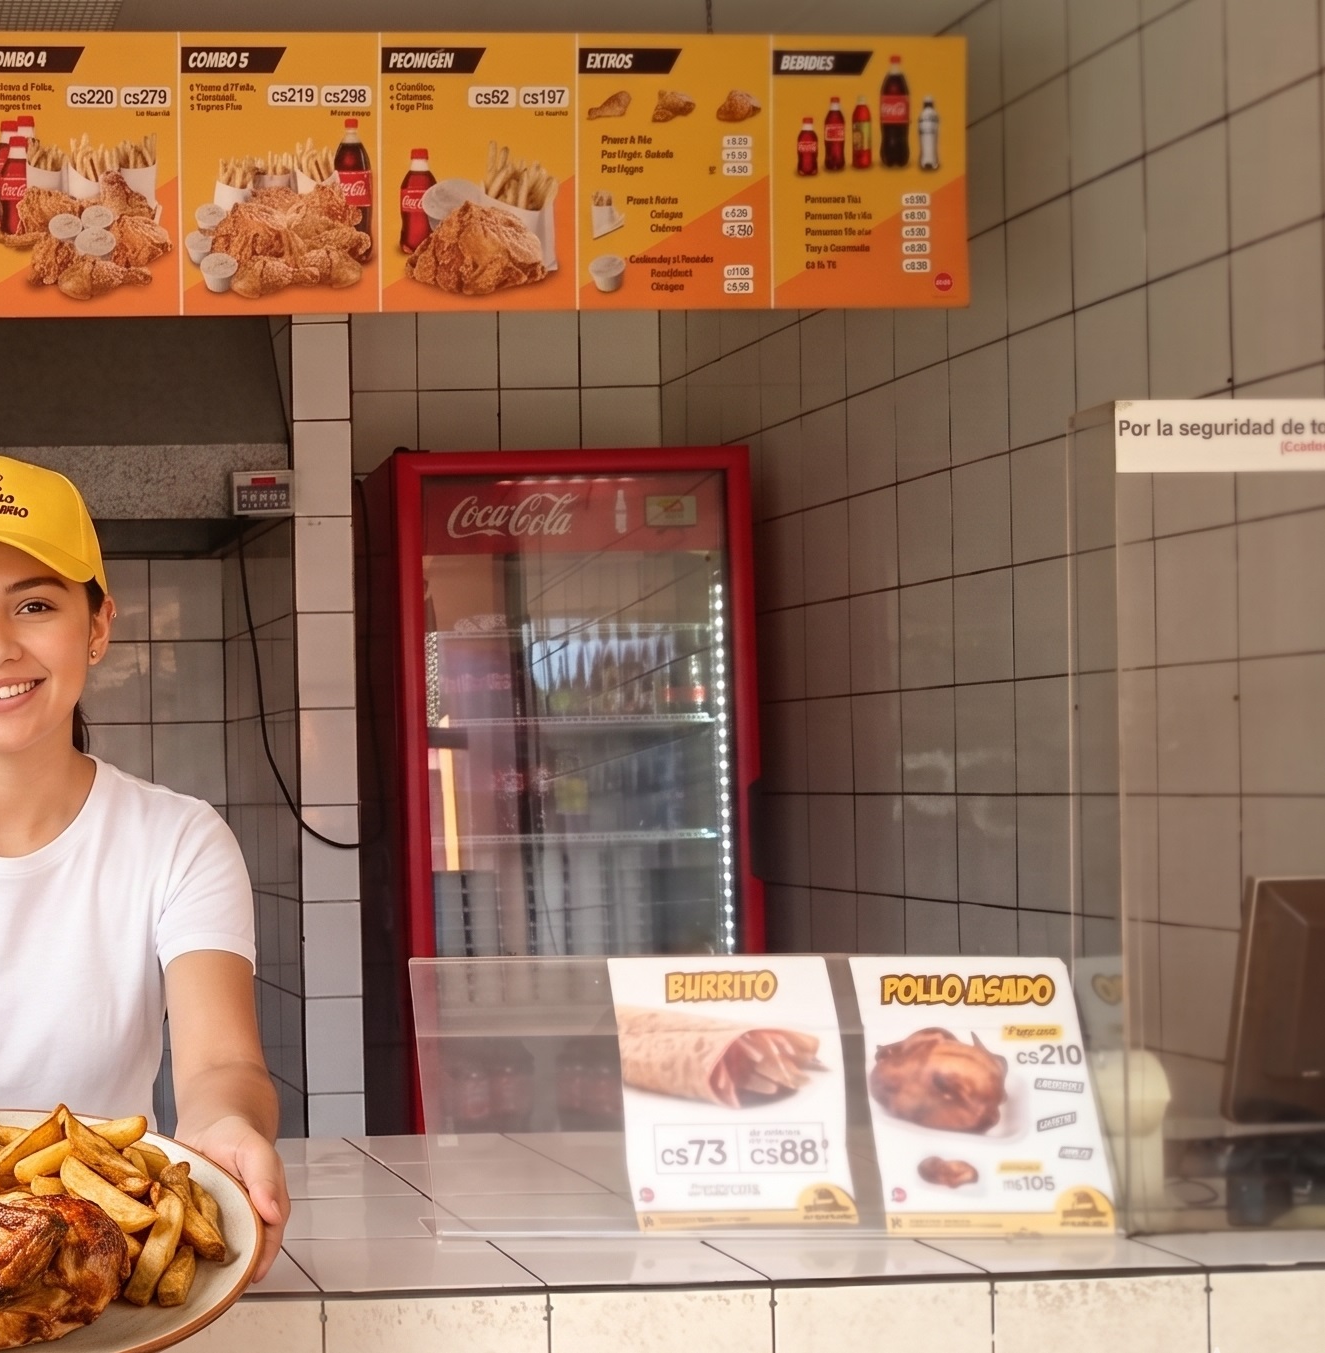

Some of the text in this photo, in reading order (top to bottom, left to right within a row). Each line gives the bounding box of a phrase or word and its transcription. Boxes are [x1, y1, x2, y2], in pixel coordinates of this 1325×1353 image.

[37, 52, 47, 68] 4
[188, 52, 249, 68] COMBO 5
[586, 53, 634, 69] EXTROS
[780, 55, 835, 71] BEBIDIES
[70, 90, 113, 104] cs220
[124, 90, 167, 104] cs279
[272, 88, 314, 103] cs219
[325, 89, 367, 103] cs298
[523, 90, 565, 104] cs197
[1119, 420, 1151, 436] Por
[1157, 419, 1173, 436] la
[1179, 418, 1275, 439] seguridad
[1281, 419, 1305, 435] de
[665, 970, 778, 1004] BURRITO
[880, 974, 1056, 1007] POLLO ASADO
[1016, 1044, 1082, 1065] cs210
[660, 1139, 727, 1166] cs73
[750, 1138, 819, 1166] cs88
